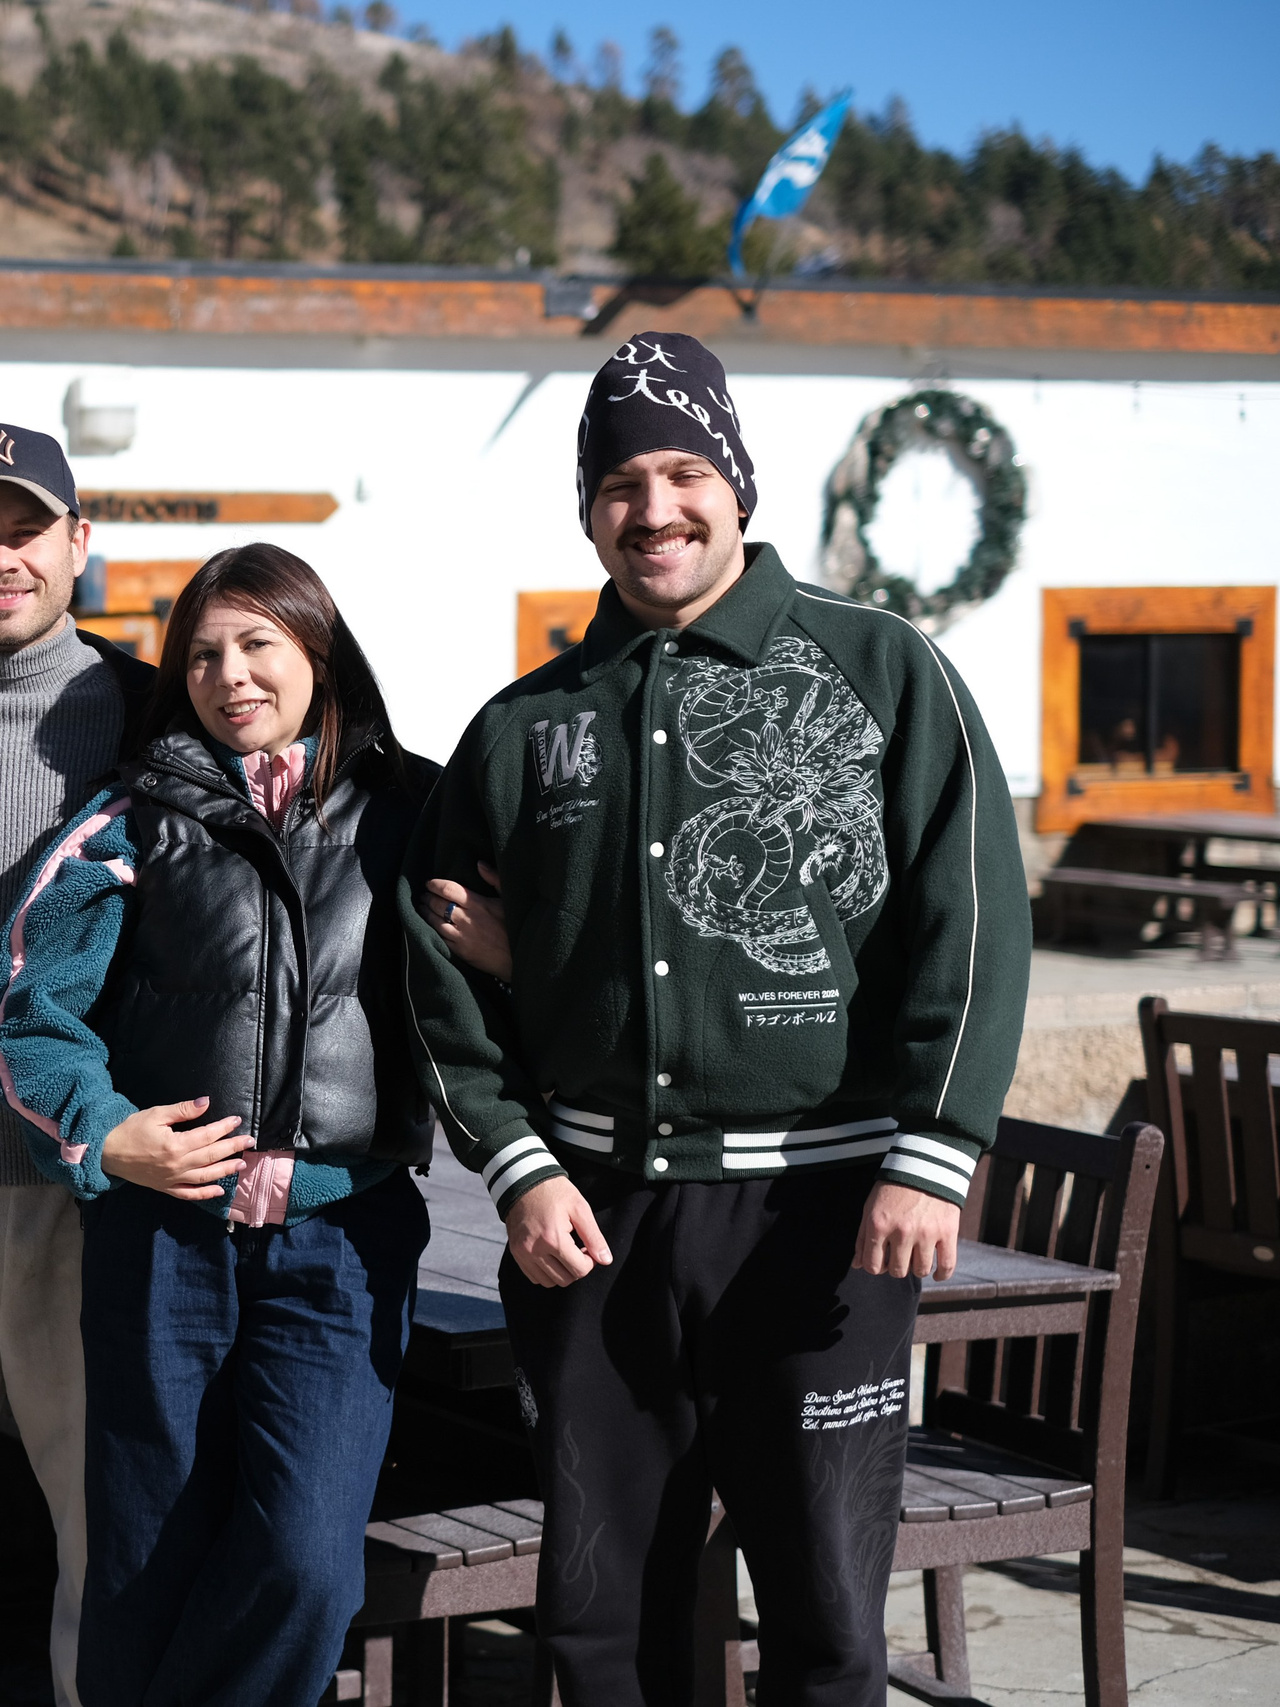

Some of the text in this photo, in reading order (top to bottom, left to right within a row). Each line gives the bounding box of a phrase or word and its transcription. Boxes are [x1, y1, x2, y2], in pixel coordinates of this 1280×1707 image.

[738, 988, 840, 1002] WOLVES FOREVER 2024
[746, 1010, 837, 1028] ドラゴンボールZ
[803, 1391, 831, 1404] Duro
[832, 1388, 856, 1405] Sport
[801, 1405, 842, 1417] Brothers
[843, 1400, 859, 1414] and
